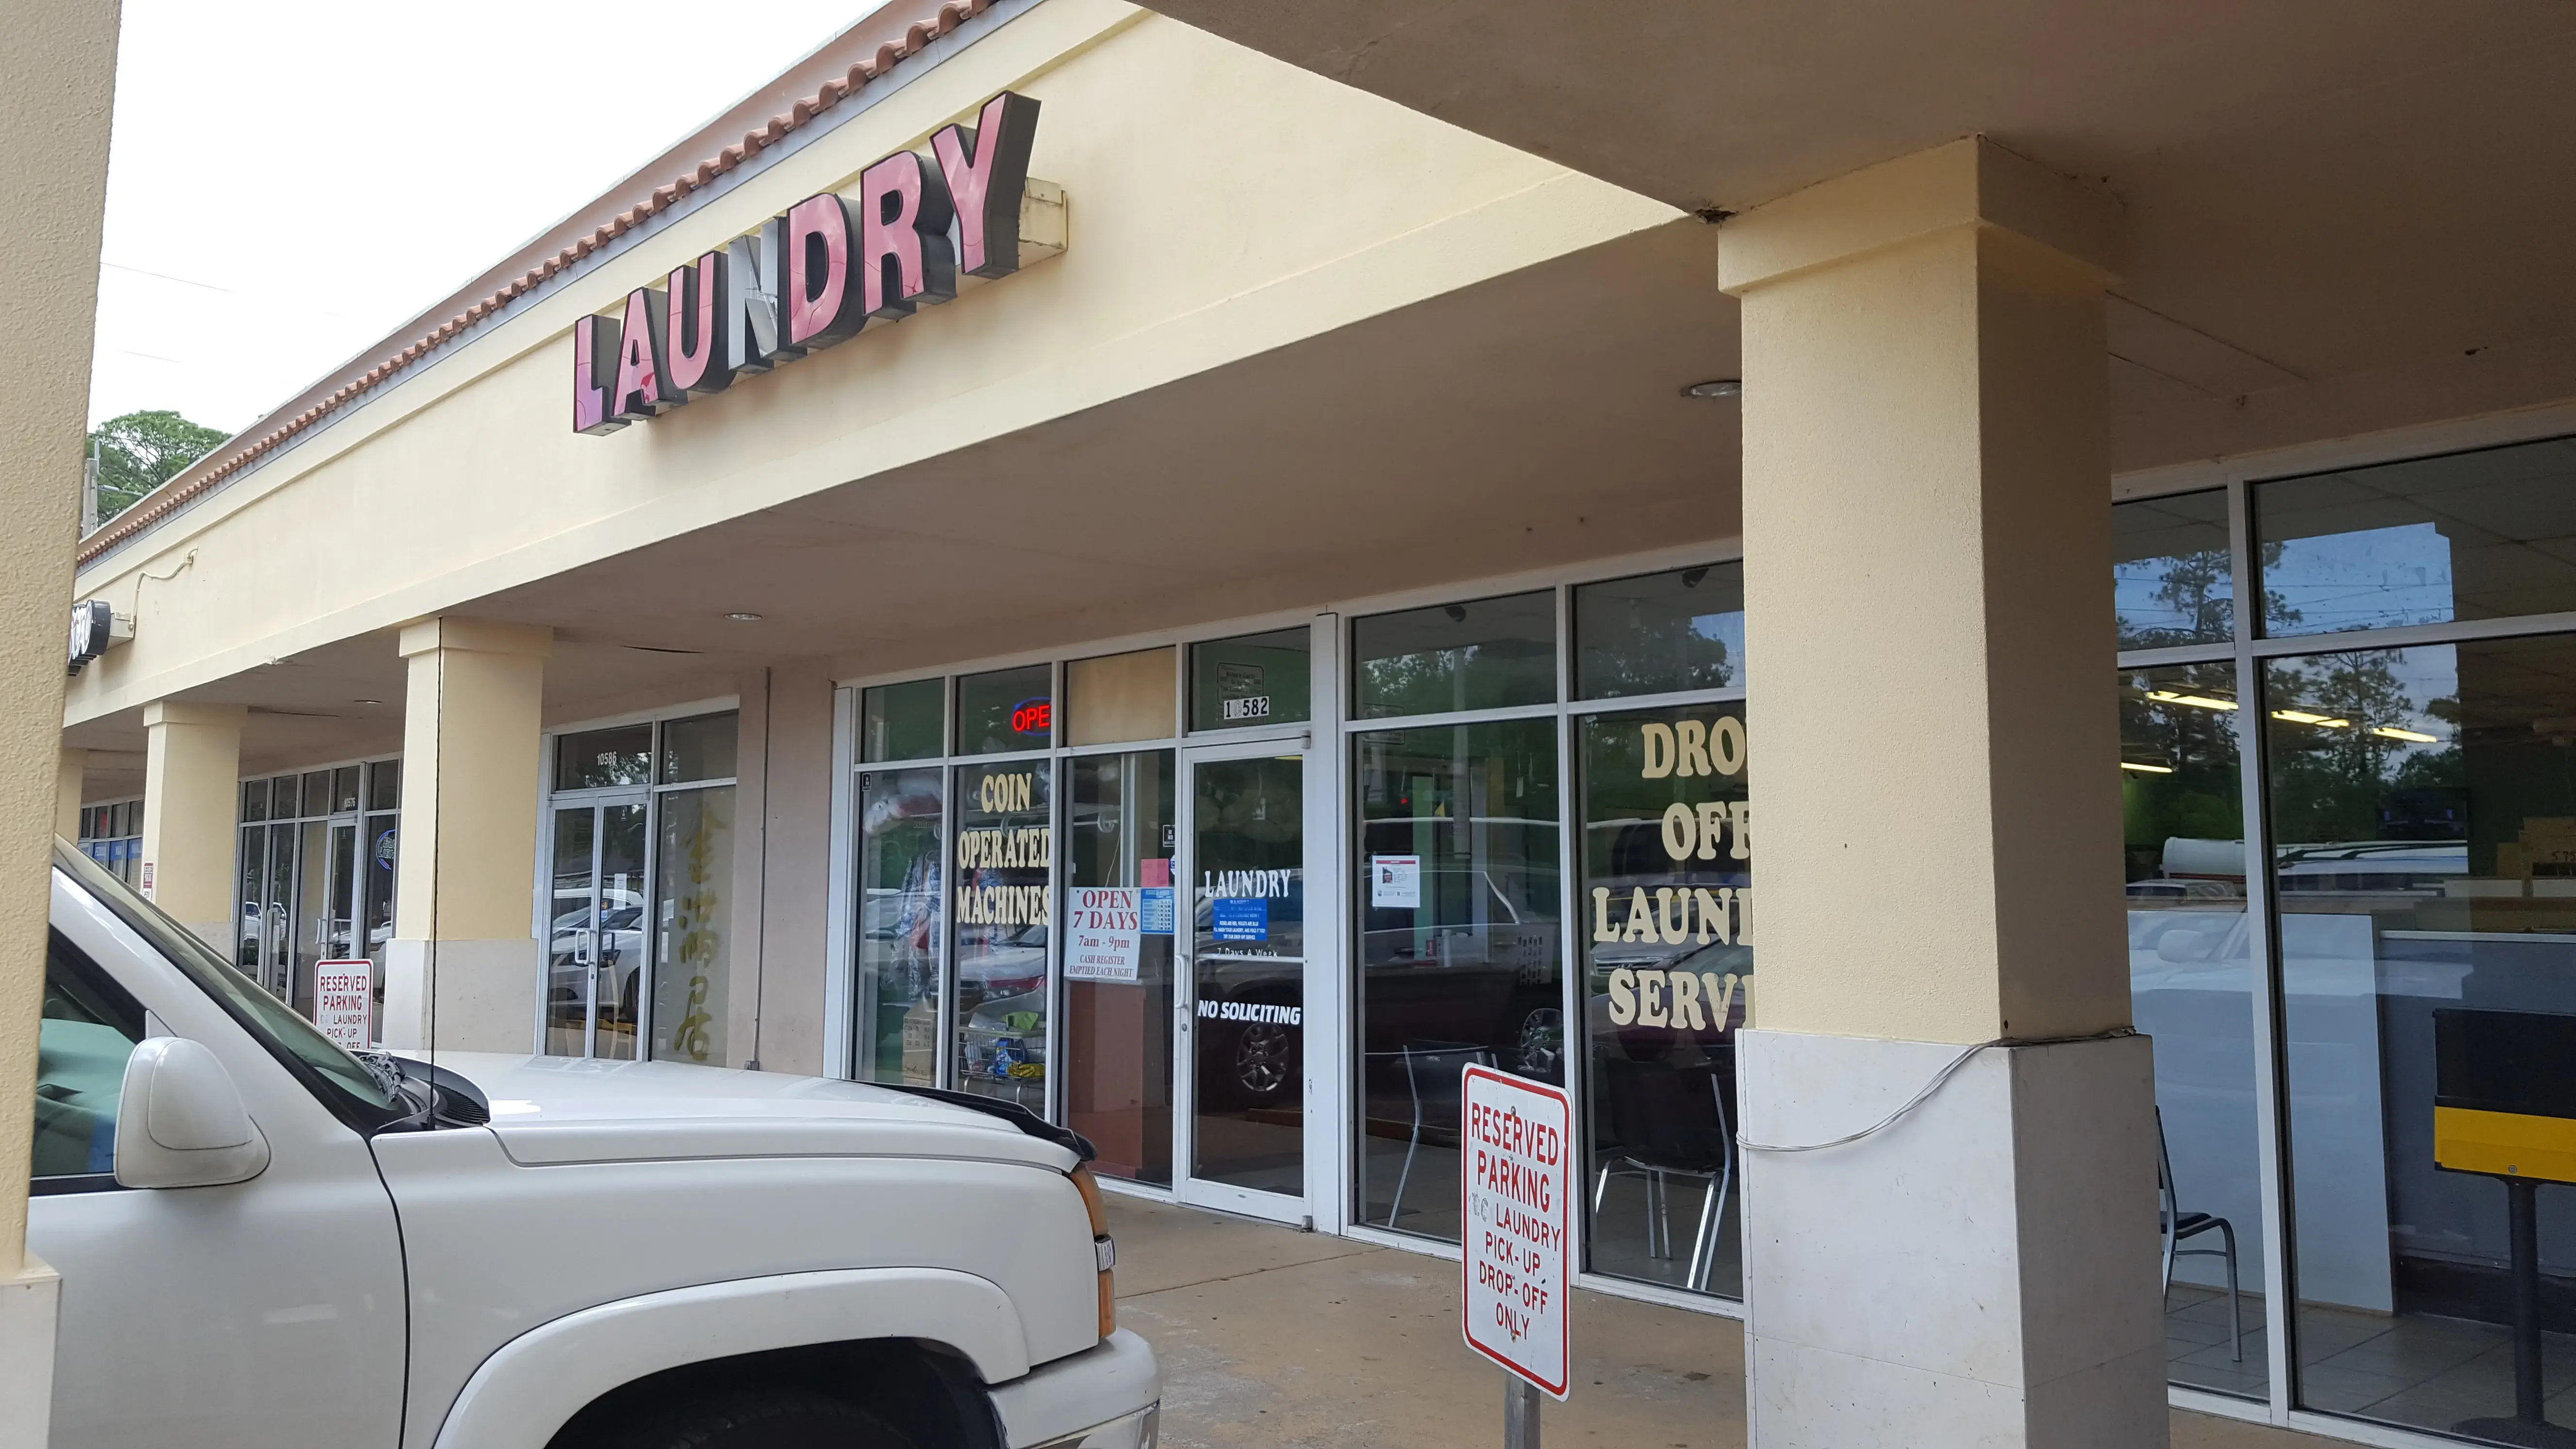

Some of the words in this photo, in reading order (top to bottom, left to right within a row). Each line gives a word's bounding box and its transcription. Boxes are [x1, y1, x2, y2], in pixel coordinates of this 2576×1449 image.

[573, 90, 1041, 435] LAUNDRY
[1013, 705, 1050, 731] OPE
[1226, 697, 1268, 718] 10582
[597, 751, 617, 766] 10586
[1641, 716, 1746, 778] DRO
[981, 773, 1032, 813] COIN
[958, 828, 1050, 869] OPERATED
[1205, 869, 1291, 897] LAUNDRY
[1082, 890, 1133, 908] OPEN
[1073, 911, 1084, 928] 7
[1088, 911, 1138, 930] DAYS
[1593, 886, 1753, 946] LAUN
[1078, 935, 1099, 947] 7am
[1109, 936, 1130, 951] 9pm
[1247, 949, 1252, 957] A
[1256, 949, 1278, 957] Week
[1069, 965, 1095, 974] EMPTIED
[1096, 967, 1112, 975] EACH
[1112, 967, 1133, 977] NIGHT
[1080, 954, 1095, 963] CASH
[1096, 955, 1125, 965] REGISTER
[320, 976, 367, 991] RESERVED
[323, 995, 362, 1011] PARKING
[1197, 1000, 1218, 1018] NO
[1220, 1002, 1301, 1025] SOLICITING
[333, 1014, 368, 1024] LAUNDRY
[348, 1028, 357, 1038] UP
[1471, 1102, 1559, 1166] RESERVED
[1478, 1150, 1550, 1212] PARKING
[1496, 1203, 1561, 1253] LAUNDRY
[1523, 1248, 1541, 1276] UP
[1523, 1281, 1548, 1315] OFF
[1496, 1302, 1530, 1341] ONLY
